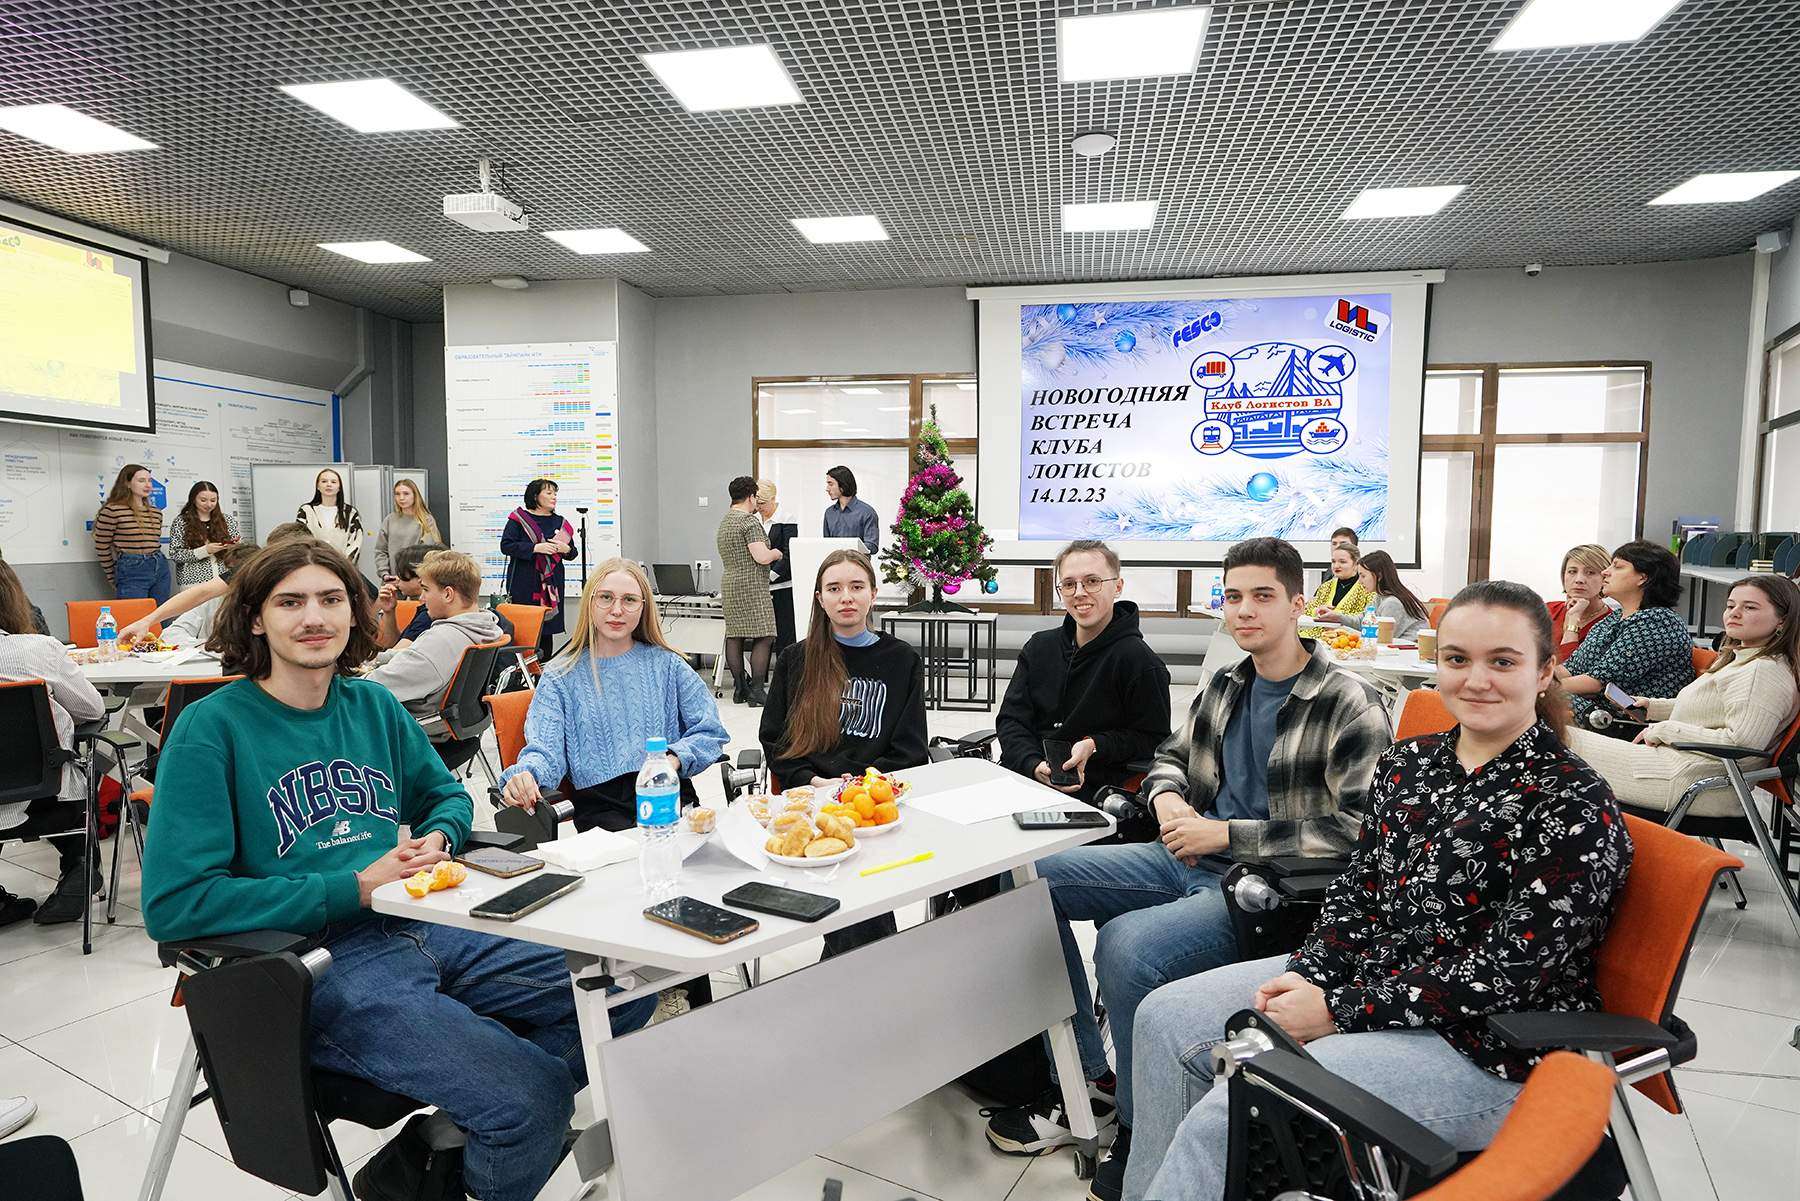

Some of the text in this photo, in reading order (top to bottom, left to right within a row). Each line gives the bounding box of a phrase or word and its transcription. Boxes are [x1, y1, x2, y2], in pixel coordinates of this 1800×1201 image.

[1172, 311, 1222, 348] FESCO
[1329, 320, 1376, 343] LOGISTIC
[1030, 385, 1191, 406] НОВОГОДНЯЯ
[1211, 398, 1333, 411] Клуб Логистов ВЛ
[1030, 413, 1132, 431] ВСТРЕЧА
[1029, 439, 1102, 456] КЛУБА
[1028, 462, 1152, 479] ЛОГИСТОВ
[1030, 488, 1106, 503] 14.12.23
[266, 759, 399, 859] NBSC
[316, 840, 331, 850] The
